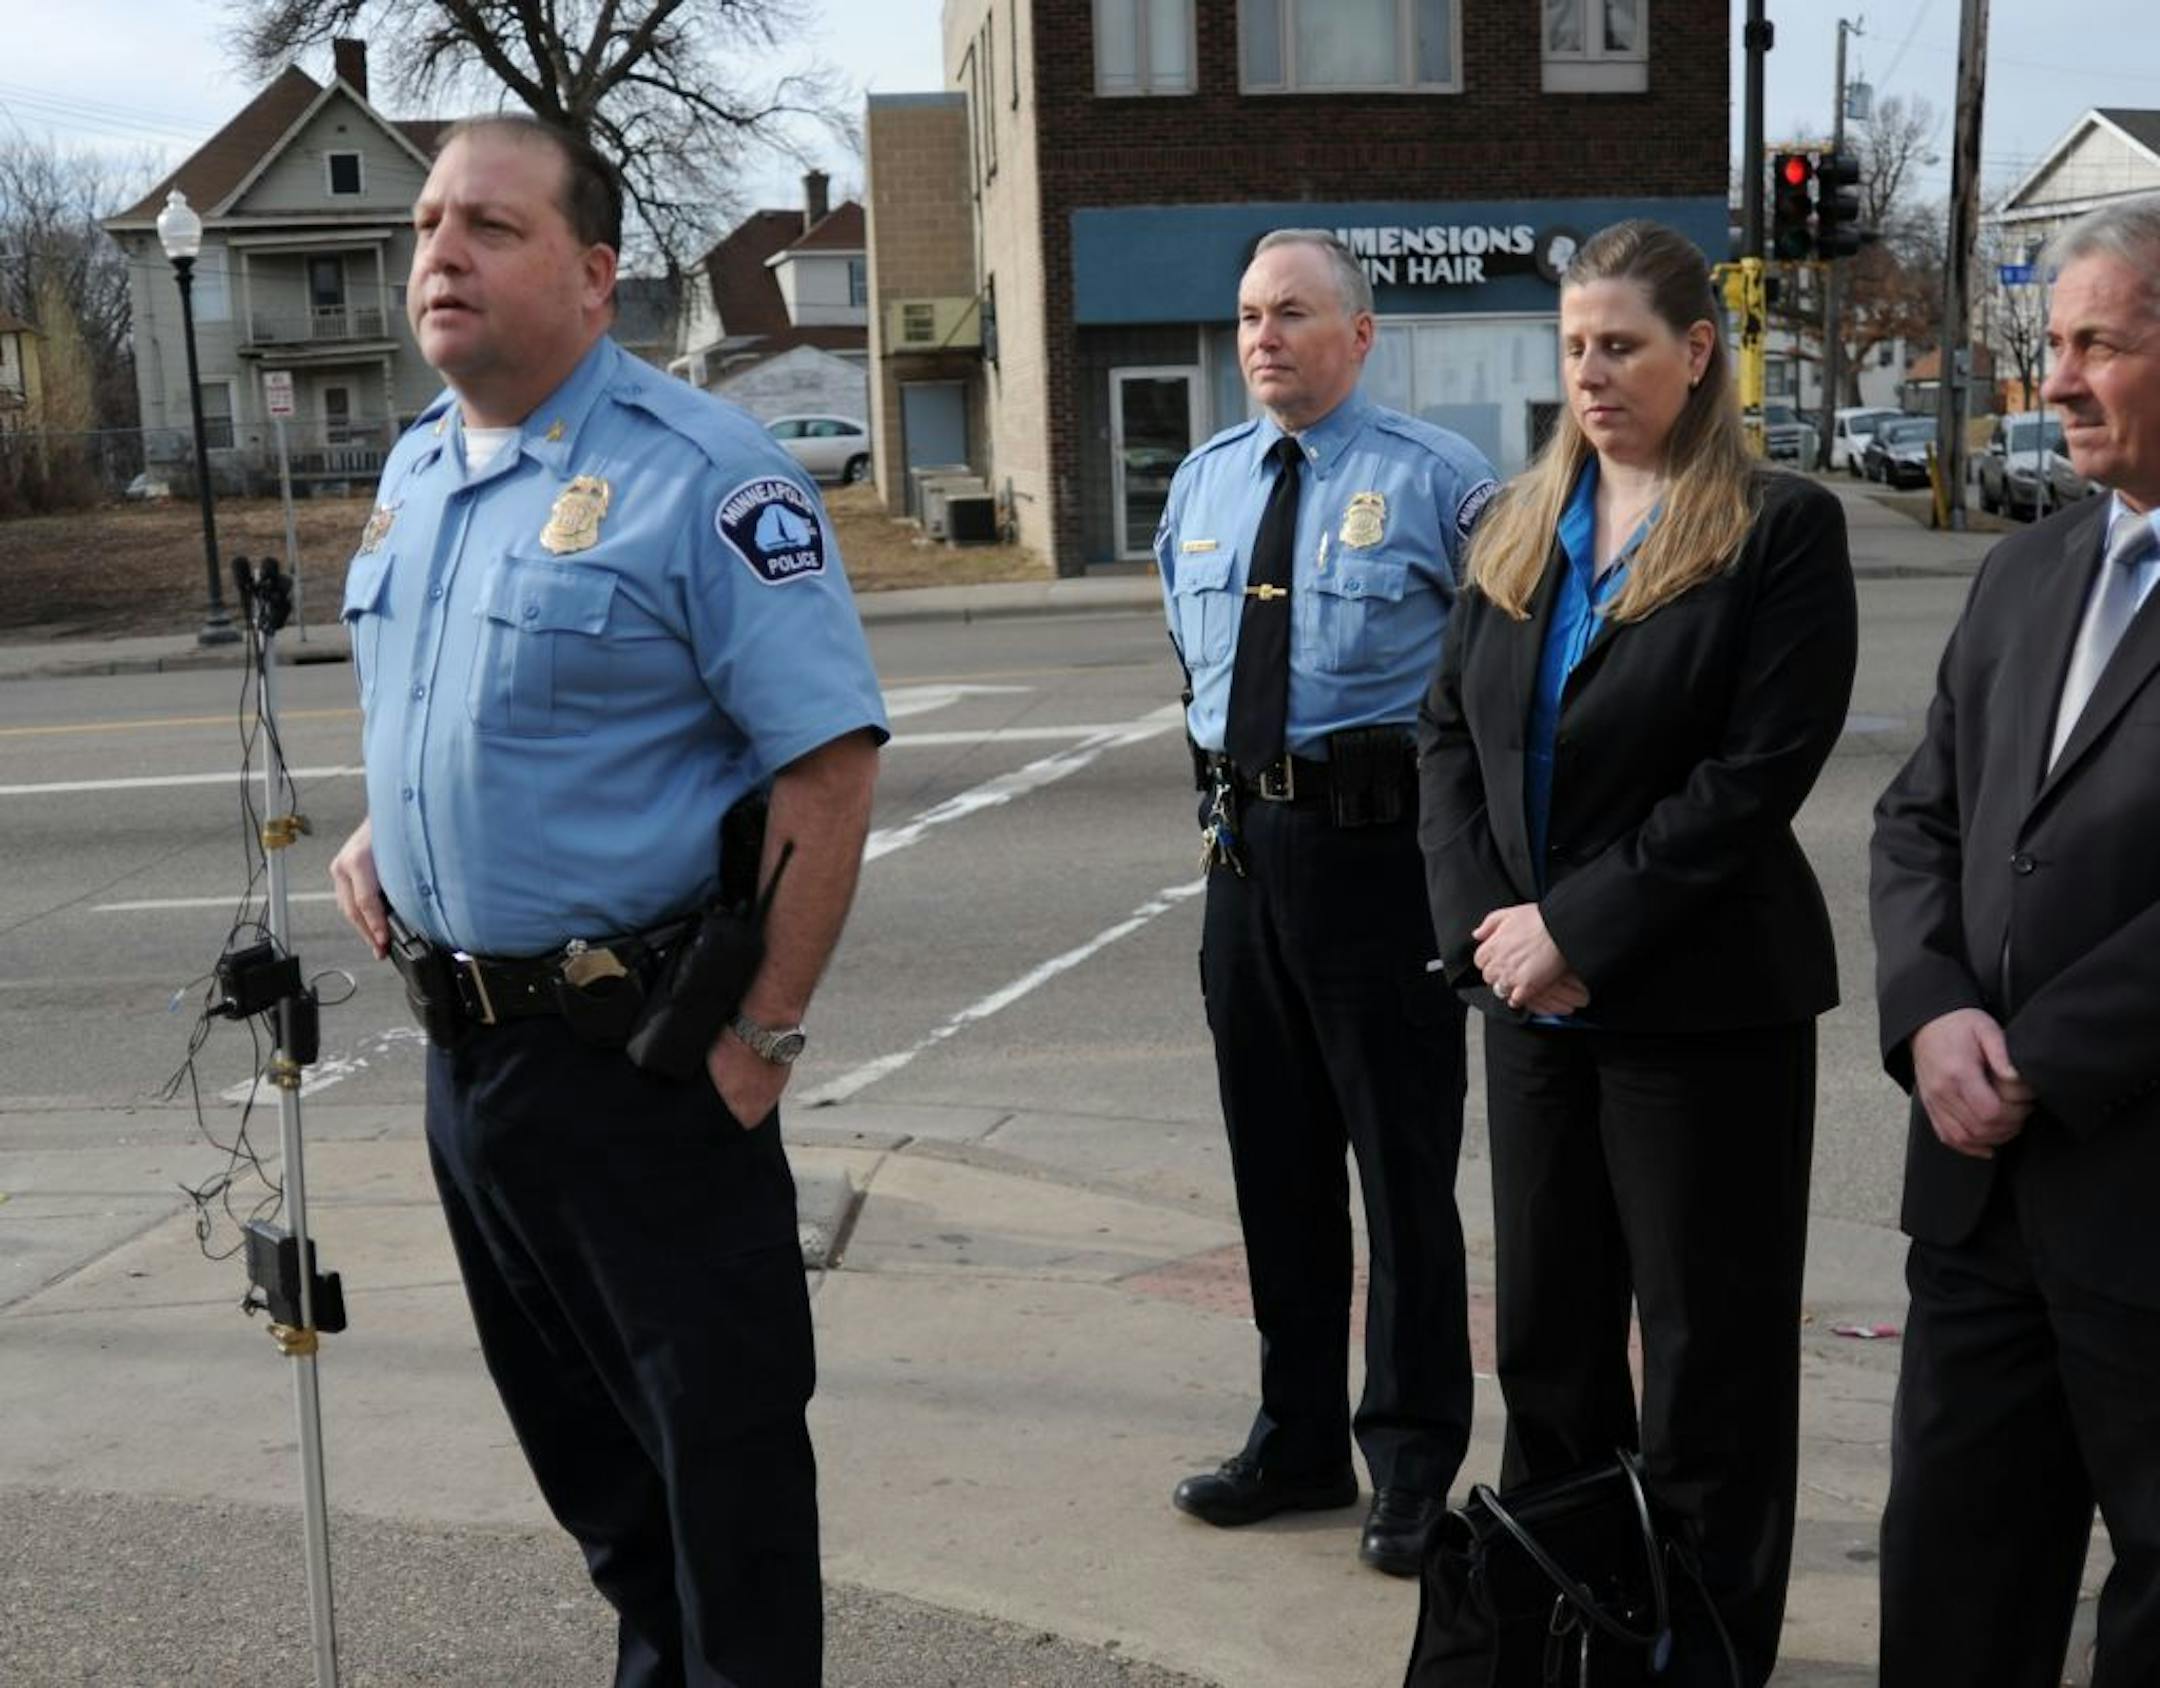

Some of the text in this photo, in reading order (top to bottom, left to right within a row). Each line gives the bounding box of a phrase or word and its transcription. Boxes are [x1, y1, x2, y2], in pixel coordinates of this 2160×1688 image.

[1336, 226, 1536, 256] IMENSIONS
[1407, 256, 1486, 284] HAIR
[721, 482, 814, 527] MINNEAPOL
[767, 551, 818, 575] POLICE
